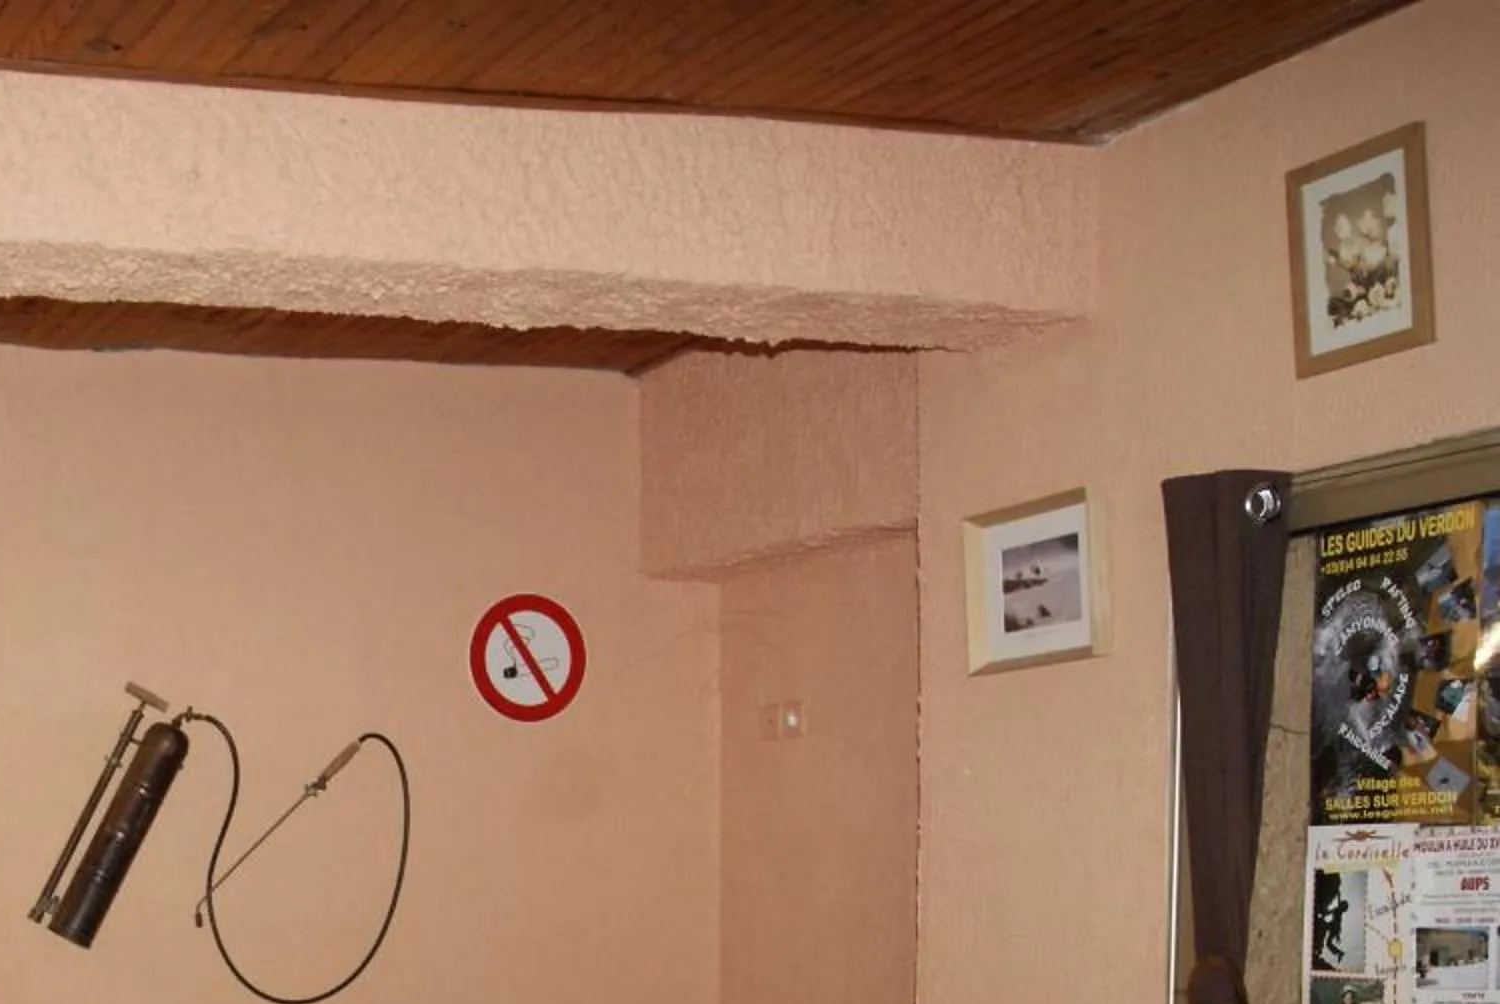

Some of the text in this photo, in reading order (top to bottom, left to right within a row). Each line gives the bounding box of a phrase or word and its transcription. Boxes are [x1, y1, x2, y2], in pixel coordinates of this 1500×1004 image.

[1321, 507, 1476, 557] LES GUIDES DU VERDON
[1369, 673, 1409, 740] ESCALADE
[1325, 791, 1458, 811] SALLES SUR VERDON
[1356, 776, 1397, 792] Village
